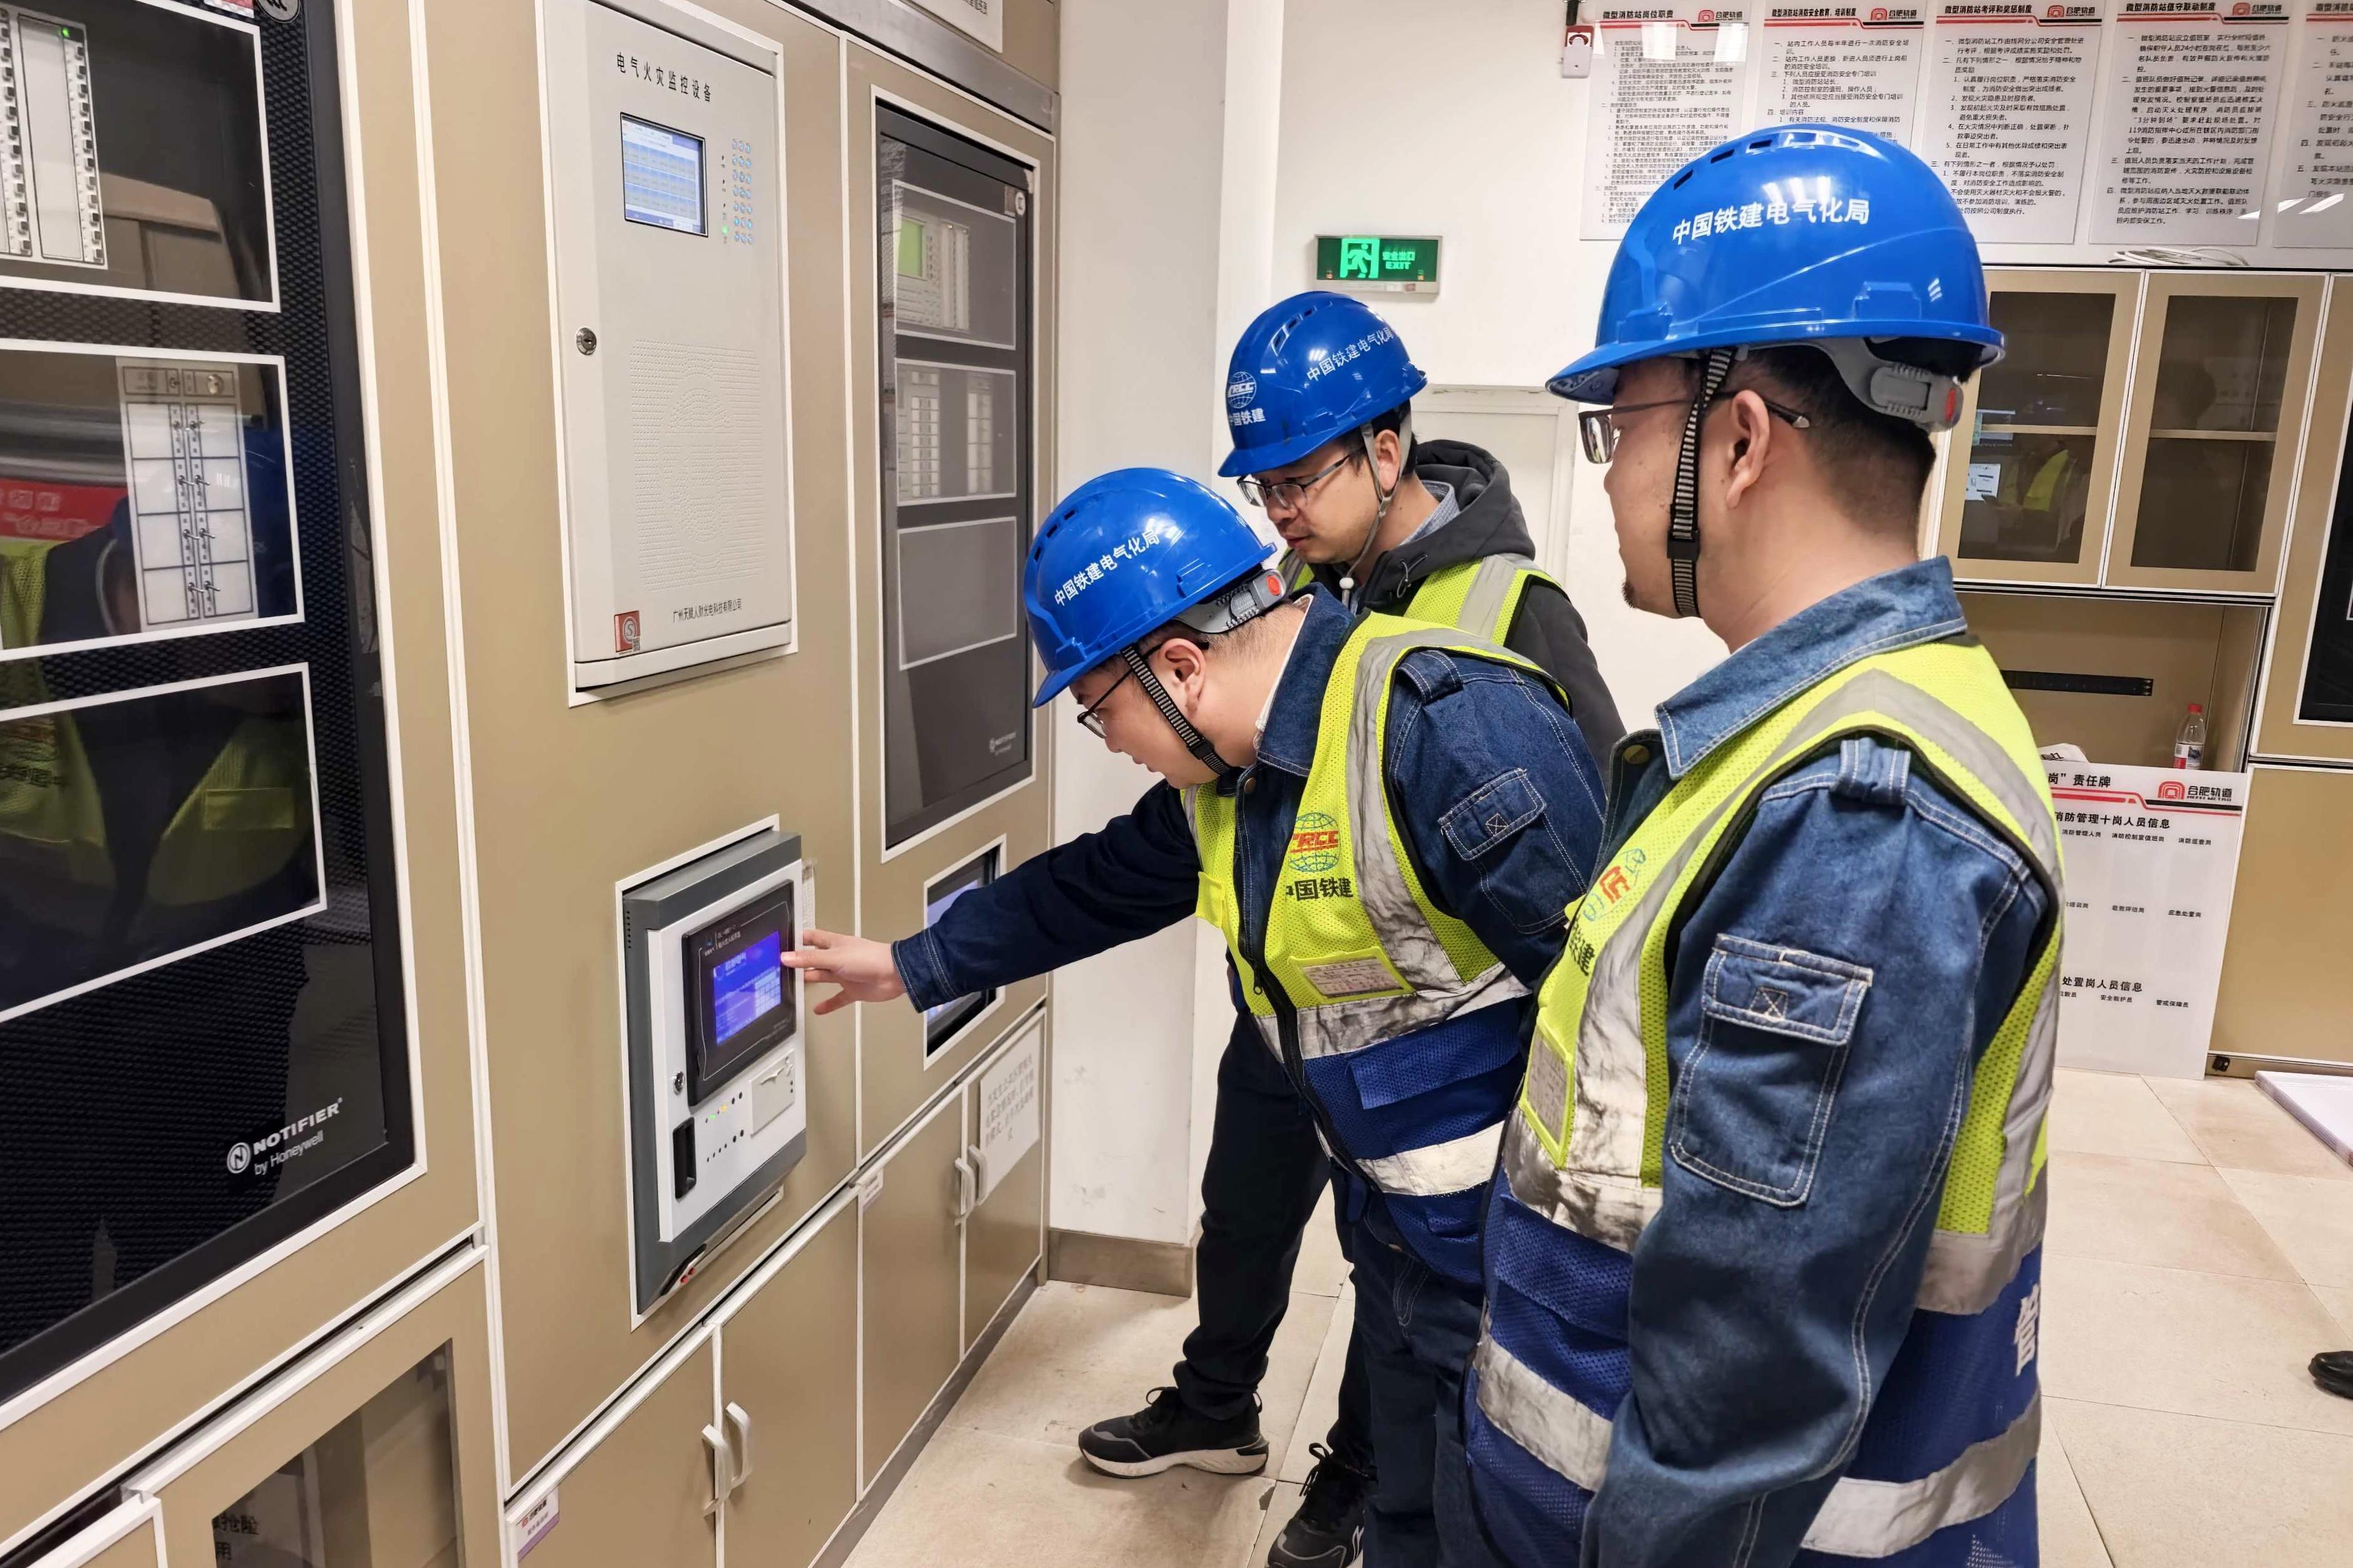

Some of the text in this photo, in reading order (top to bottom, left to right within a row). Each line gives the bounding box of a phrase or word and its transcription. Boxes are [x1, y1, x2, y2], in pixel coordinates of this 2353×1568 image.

[1602, 9, 1674, 19] 微型消防站岗位职责
[1772, 8, 1857, 17] 微型消防站消防安全教育、培训制度
[1944, 5, 2033, 14] 微型消防站考评和奖惩制度
[2126, 3, 2216, 12] 微型消防站值守联动制度
[616, 51, 711, 103] 电气火灾监控设备
[1954, 198, 2037, 206] 故不参加消防培训、演练的。
[1672, 196, 1871, 245] 中国铁建电气化局
[1382, 251, 1415, 261] 安全出口
[1385, 261, 1412, 270] EXIT
[1306, 327, 1395, 383] 中国铁建电气化局
[1054, 529, 1161, 607] 中国铁建电气化局
[2187, 785, 2233, 798] 合肥轨道
[2062, 976, 2143, 993] 处置岗人员信息
[253, 1102, 339, 1155] NOTIFIER
[254, 1129, 324, 1175] by Honeywell
